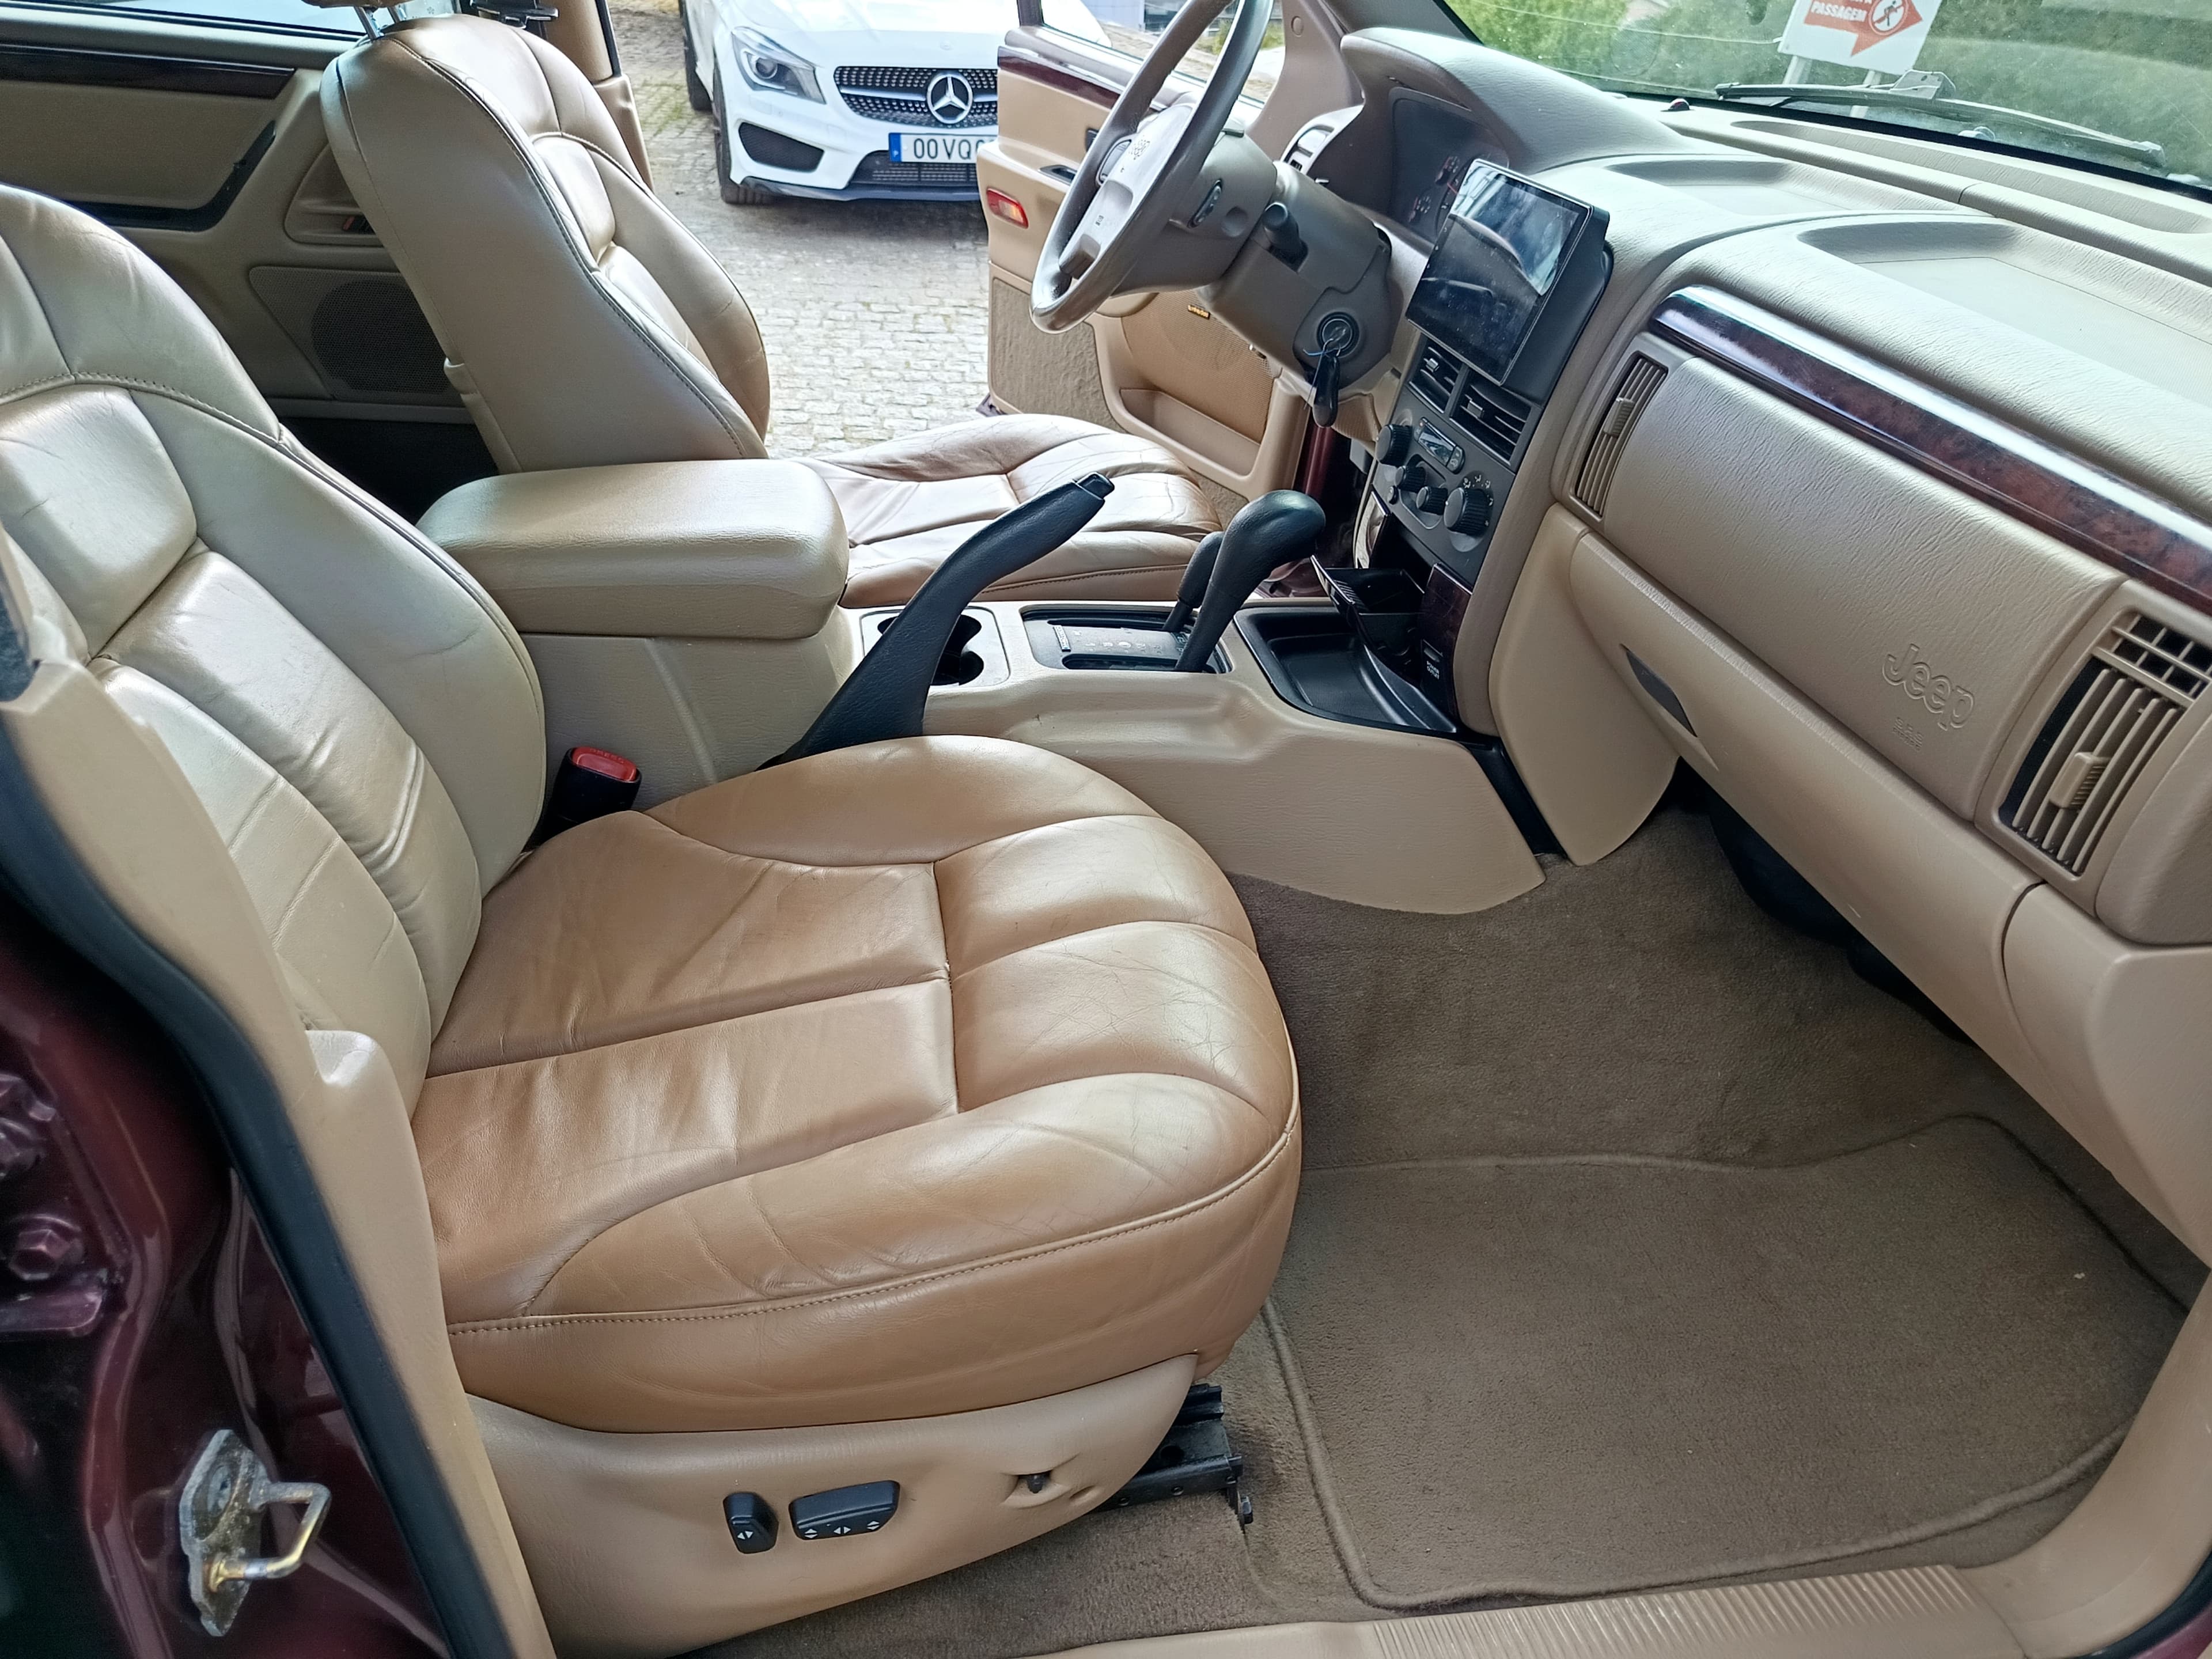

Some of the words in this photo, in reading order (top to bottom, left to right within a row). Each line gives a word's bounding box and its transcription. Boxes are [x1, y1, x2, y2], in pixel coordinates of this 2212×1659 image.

[1810, 1, 1868, 22] PASSAGEM
[914, 138, 995, 160] 00VQ
[1882, 643, 1975, 731] Jeep
